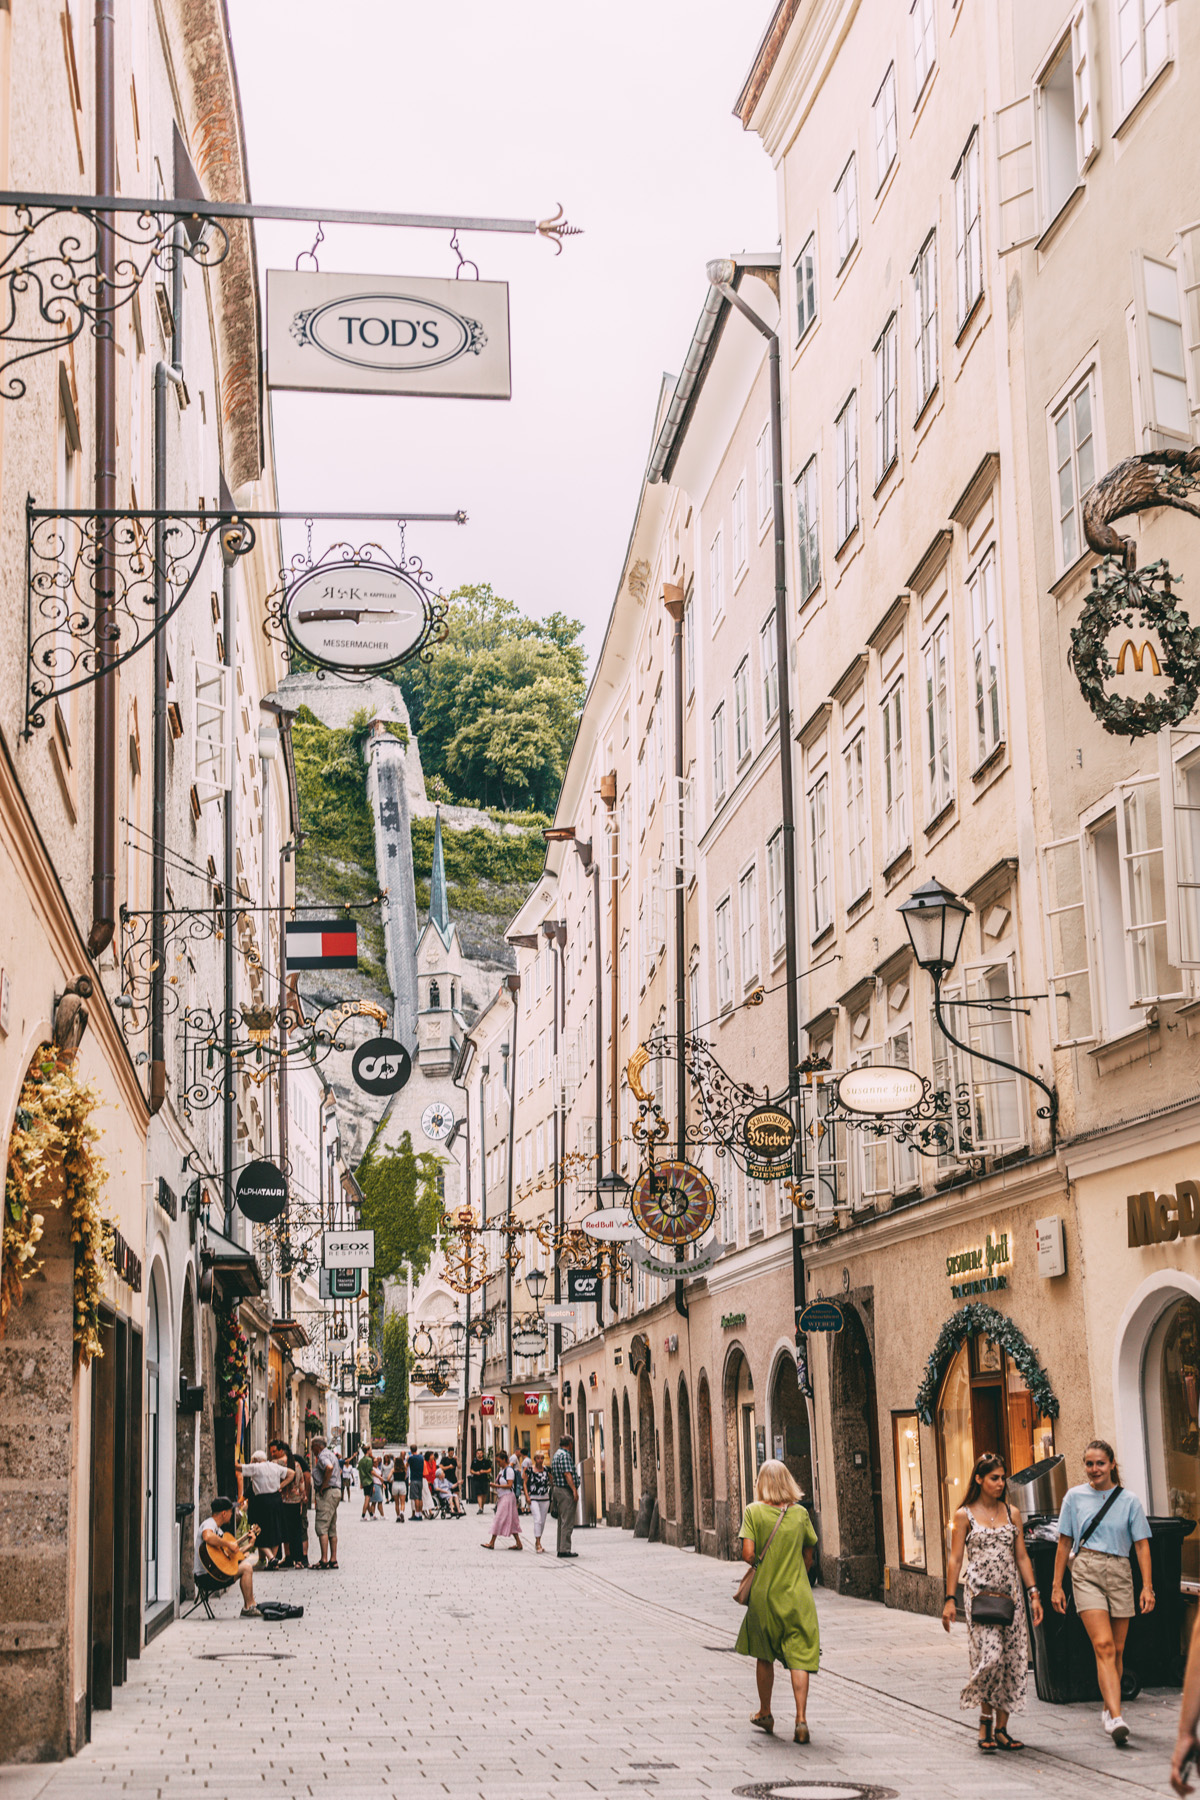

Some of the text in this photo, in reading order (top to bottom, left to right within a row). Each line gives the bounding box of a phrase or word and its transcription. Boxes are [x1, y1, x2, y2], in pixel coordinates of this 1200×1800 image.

[338, 316, 440, 349] TOD'S
[322, 639, 389, 650] MESSERMACHER
[846, 1087, 889, 1096] susanne
[749, 1114, 791, 1128] SCHLOSSEREI
[747, 1129, 792, 1147] Wieber
[752, 1170, 787, 1179] DIENST
[238, 1187, 285, 1197] ALPHATAURI
[585, 1221, 600, 1229] Red
[600, 1221, 614, 1229] Bull
[329, 1242, 369, 1251] GEOX
[641, 1257, 712, 1275] Aschauer
[546, 1309, 571, 1318] swatch
